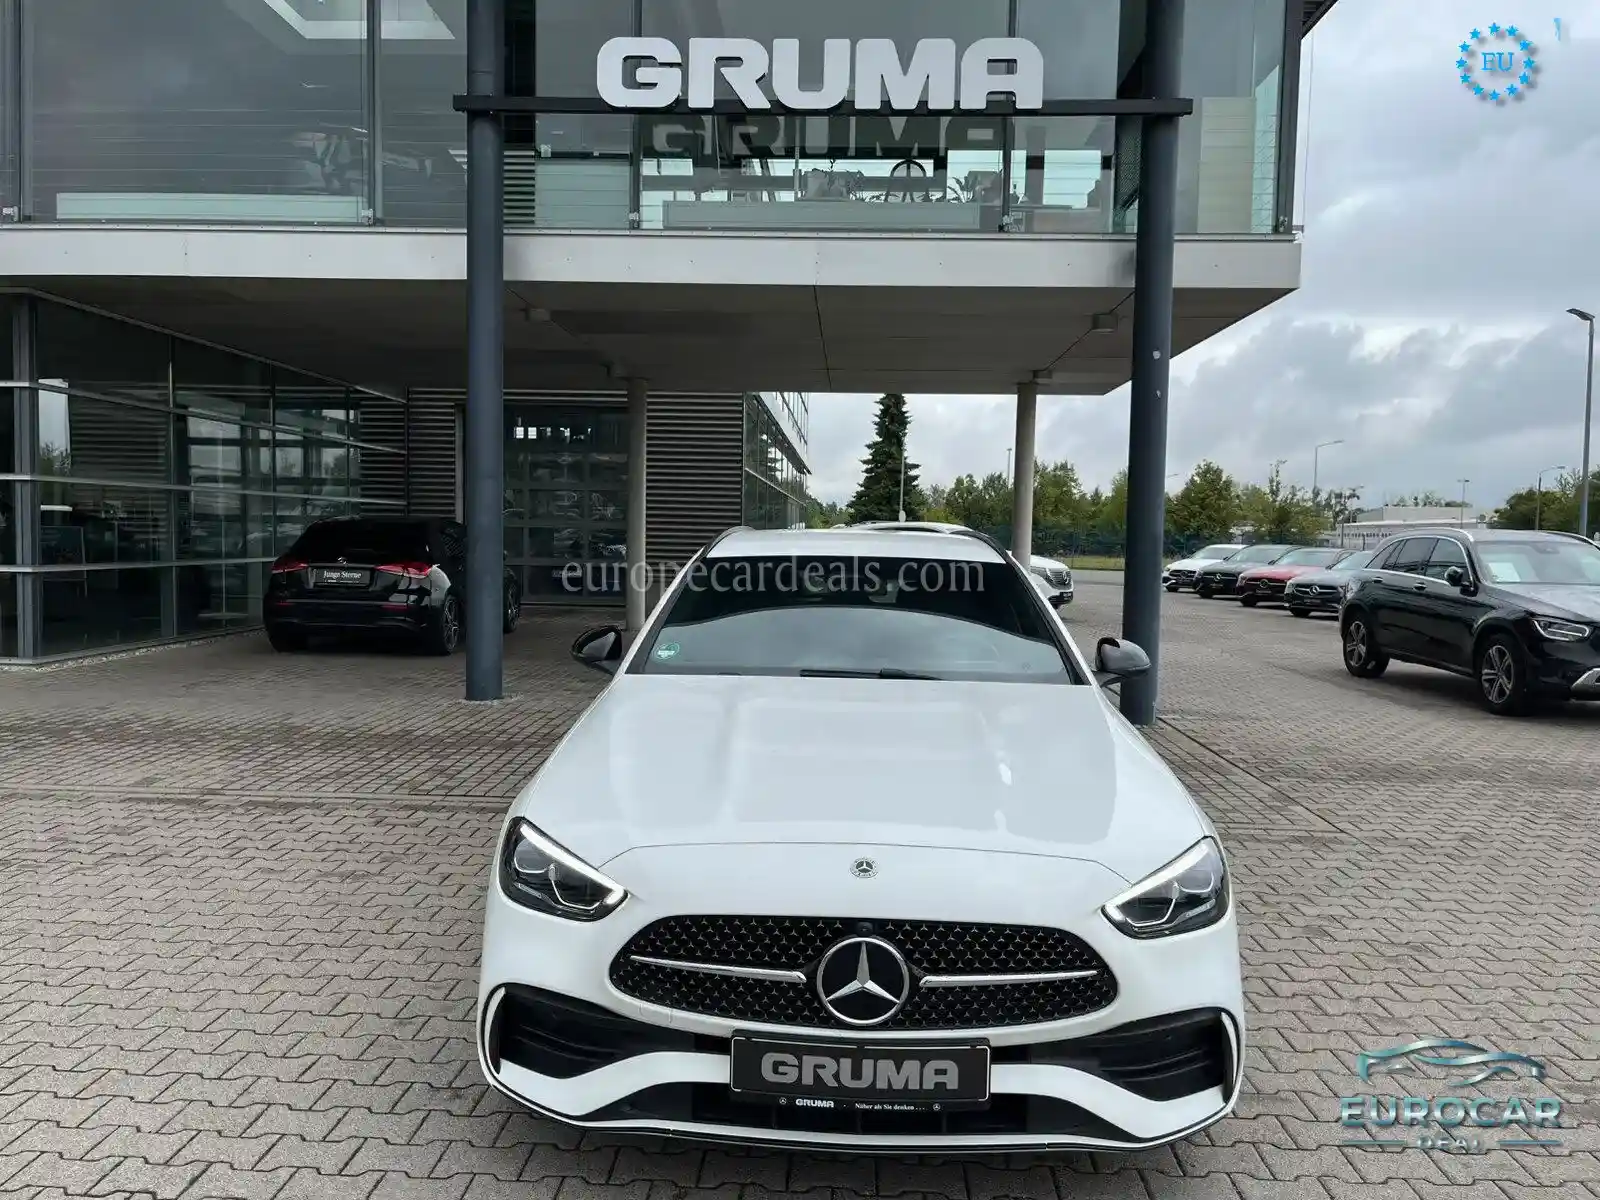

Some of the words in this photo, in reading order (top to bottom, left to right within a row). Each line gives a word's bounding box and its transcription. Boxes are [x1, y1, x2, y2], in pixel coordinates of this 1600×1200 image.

[597, 37, 1044, 110] GRUMA
[761, 1052, 959, 1090] GRUMA
[795, 1098, 835, 1108] GRUMA
